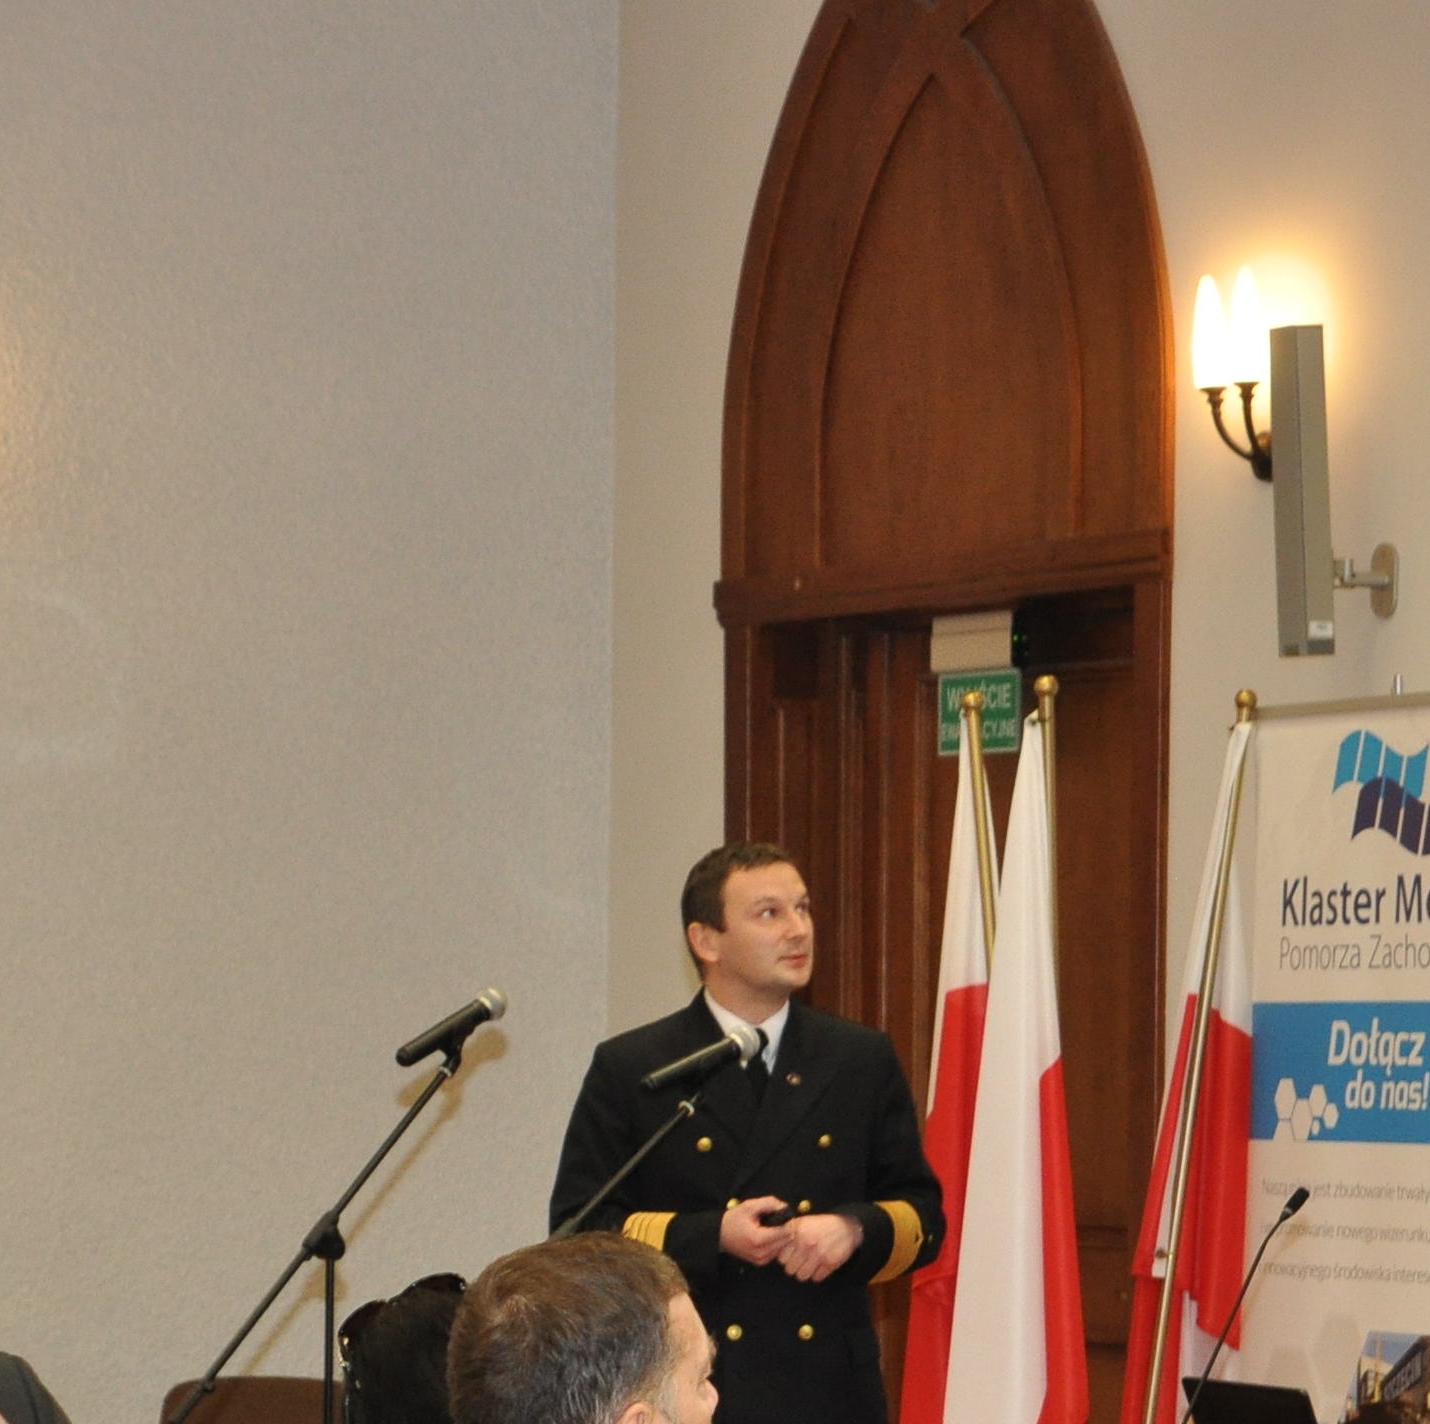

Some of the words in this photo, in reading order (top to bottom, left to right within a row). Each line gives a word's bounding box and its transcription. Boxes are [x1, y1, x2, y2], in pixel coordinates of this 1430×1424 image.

[1281, 875, 1386, 927] Klaster
[1279, 936, 1361, 971] Pomorza
[1327, 1017, 1426, 1077] Dołącz
[1345, 1068, 1376, 1110] do
[1379, 1071, 1430, 1111] nas!
